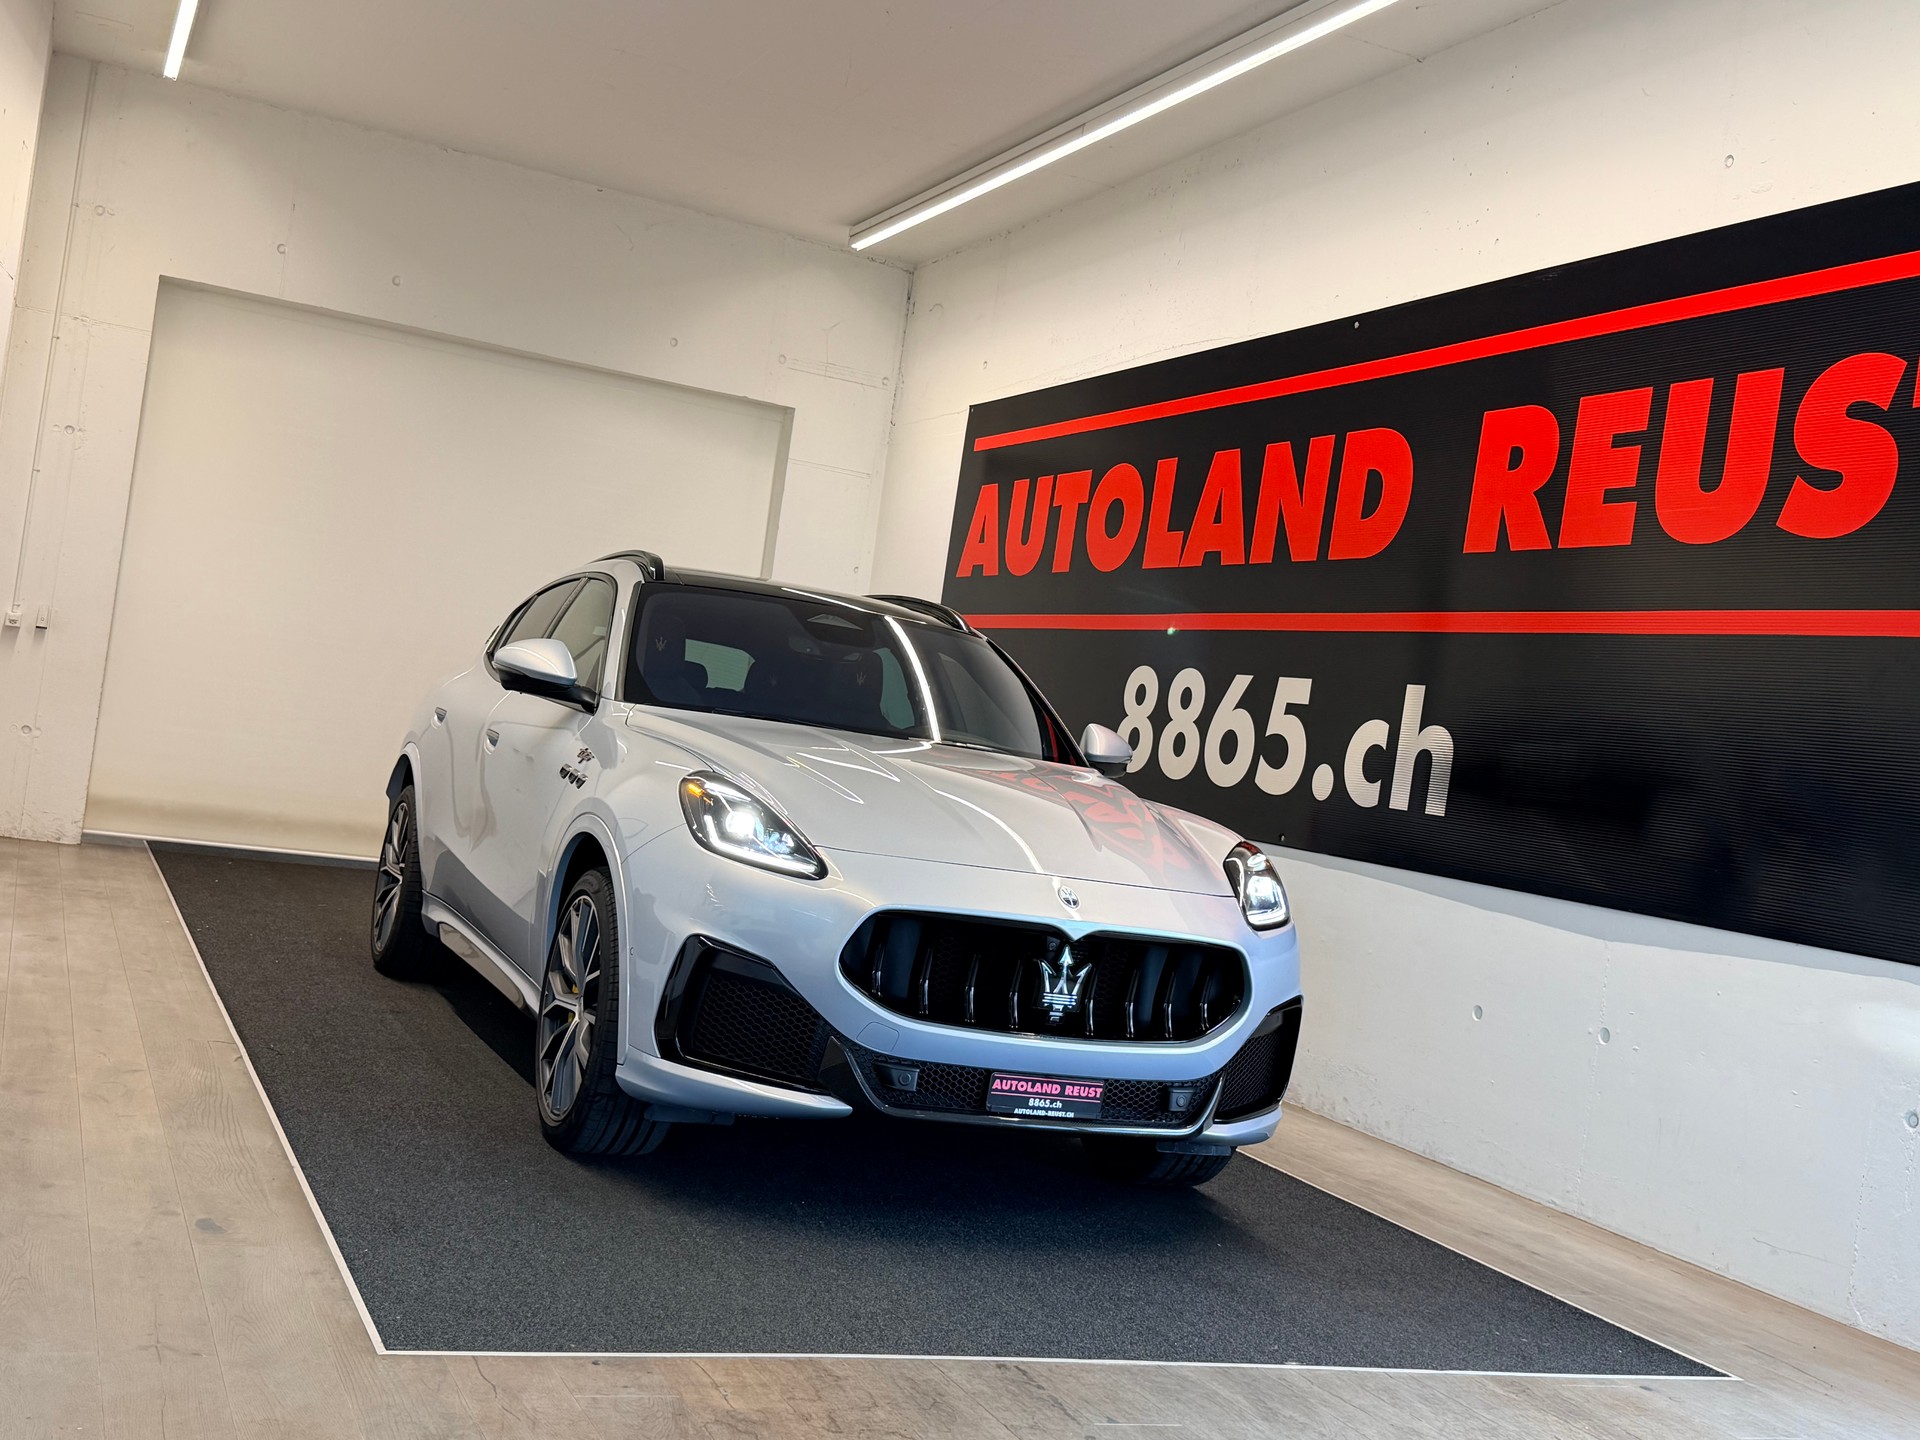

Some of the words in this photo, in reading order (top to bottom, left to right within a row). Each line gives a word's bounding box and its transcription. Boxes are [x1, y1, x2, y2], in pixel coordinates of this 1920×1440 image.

[956, 427, 1414, 579] AUTOLAND
[1463, 352, 1920, 555] REUS
[1116, 665, 1454, 817] 8865.ch
[992, 1079, 1061, 1095] AUTOLAND
[1065, 1085, 1103, 1098] REUST
[1013, 1108, 1075, 1118] AUTOLAND-REUST.CH
[1028, 1098, 1063, 1109] 8865.ch
